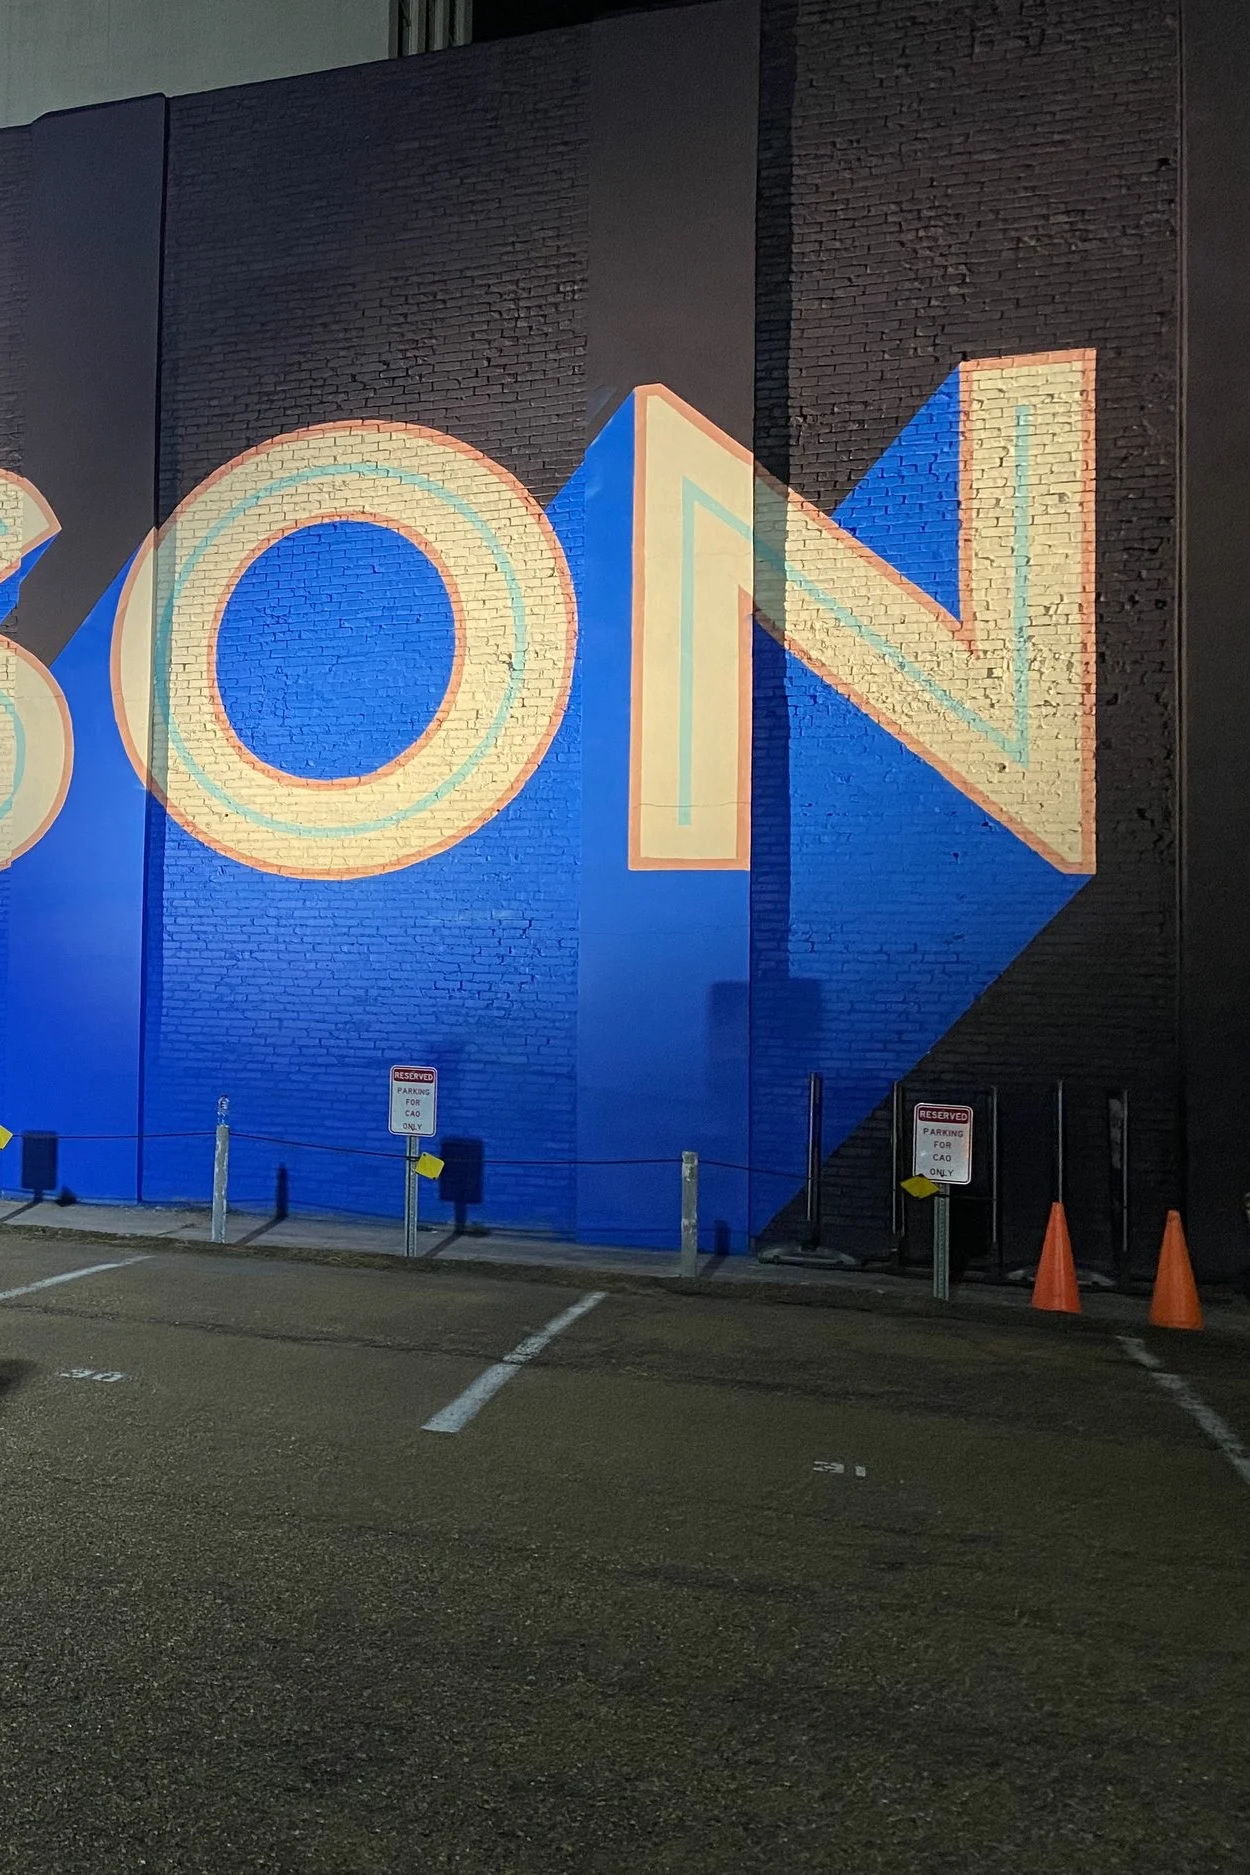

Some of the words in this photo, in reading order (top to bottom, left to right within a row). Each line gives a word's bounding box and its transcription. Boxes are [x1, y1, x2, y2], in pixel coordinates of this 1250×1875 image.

[394, 1072, 434, 1081] RESERVED
[397, 1087, 431, 1096] PARKING
[405, 1110, 421, 1118] CAO
[919, 1110, 968, 1121] RESERVED
[402, 1122, 423, 1131] ONLY
[923, 1127, 964, 1138] PARKING
[933, 1140, 952, 1149] FOR
[932, 1153, 952, 1162] CAO
[929, 1168, 955, 1177] ONLY
